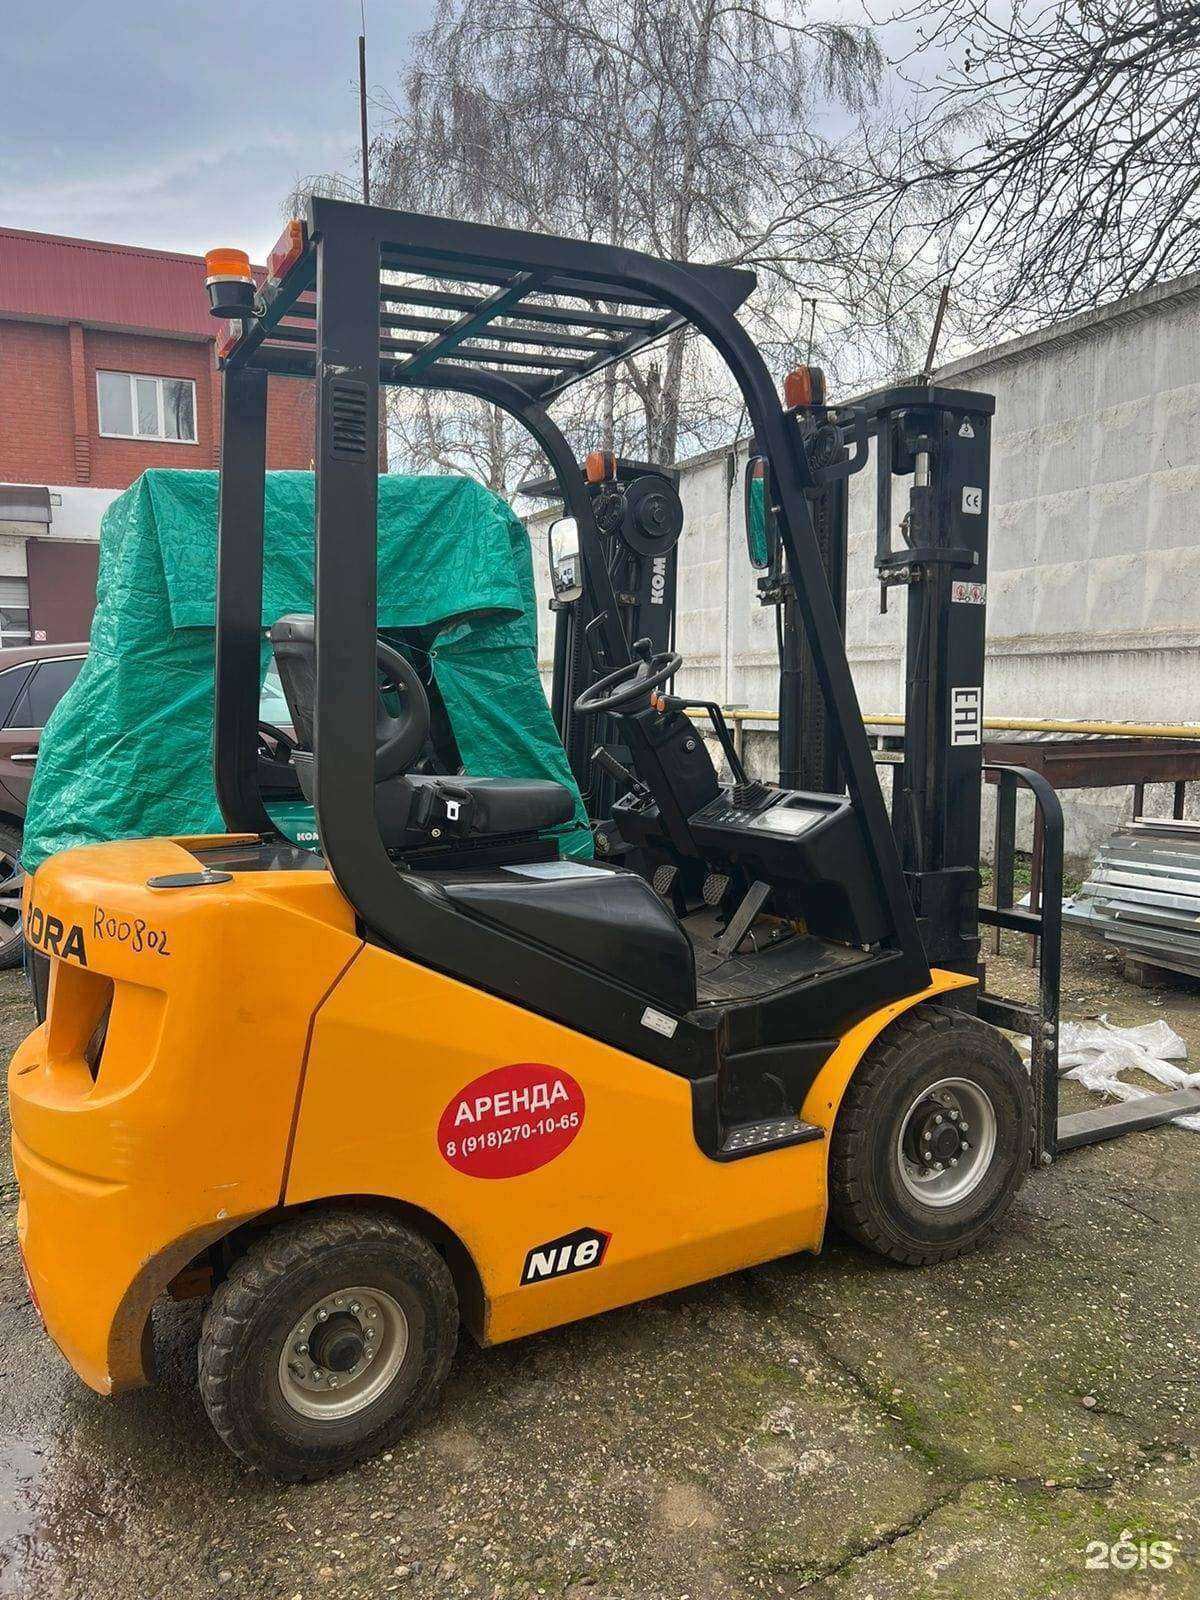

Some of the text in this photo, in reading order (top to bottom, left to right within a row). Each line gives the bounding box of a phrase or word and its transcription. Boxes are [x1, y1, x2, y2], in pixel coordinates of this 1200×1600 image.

[955, 691, 978, 743] EAC
[453, 1079, 570, 1127] АРЕНДА
[445, 1111, 580, 1158] 8 (918)270-10-65
